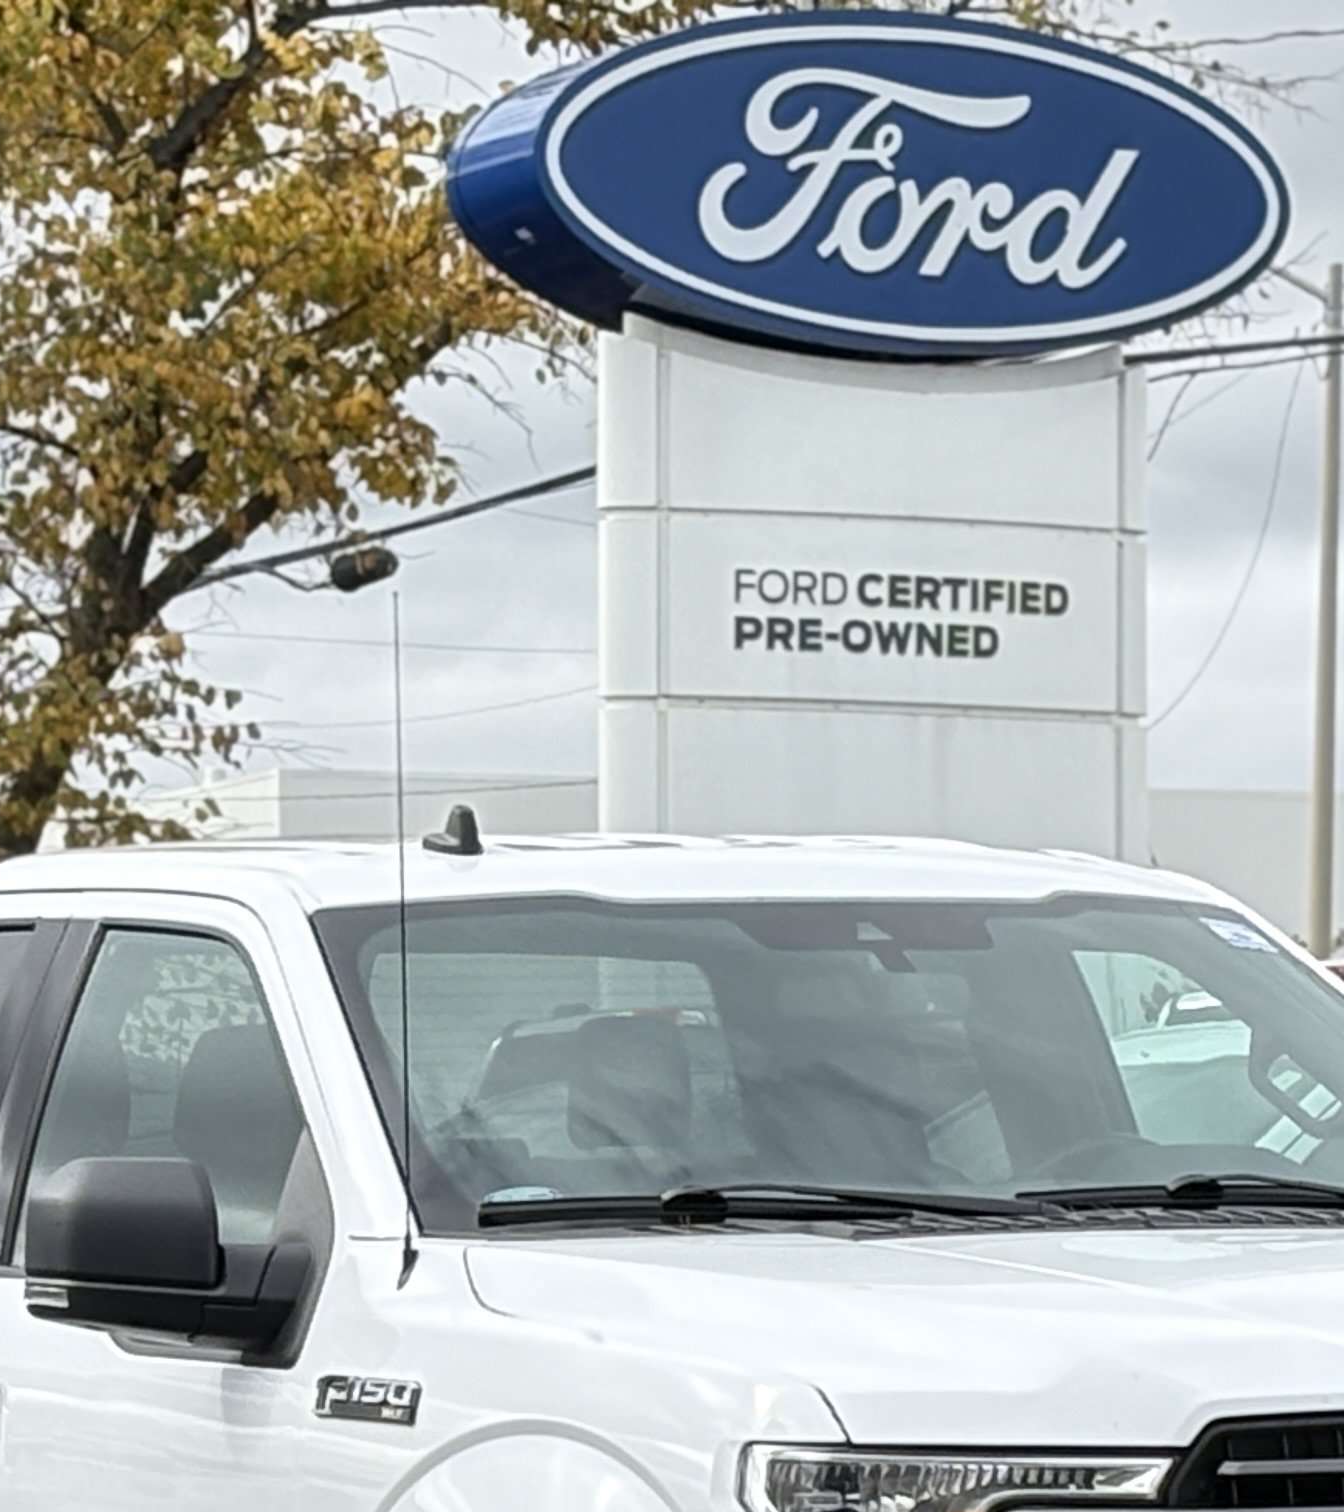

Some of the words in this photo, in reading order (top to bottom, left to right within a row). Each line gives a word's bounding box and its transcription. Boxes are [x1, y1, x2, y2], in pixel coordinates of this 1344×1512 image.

[698, 66, 1141, 289] Ford
[733, 567, 849, 606] FORD
[856, 572, 1070, 616] CERTIFIED
[733, 615, 1000, 659] PRE-OWNED
